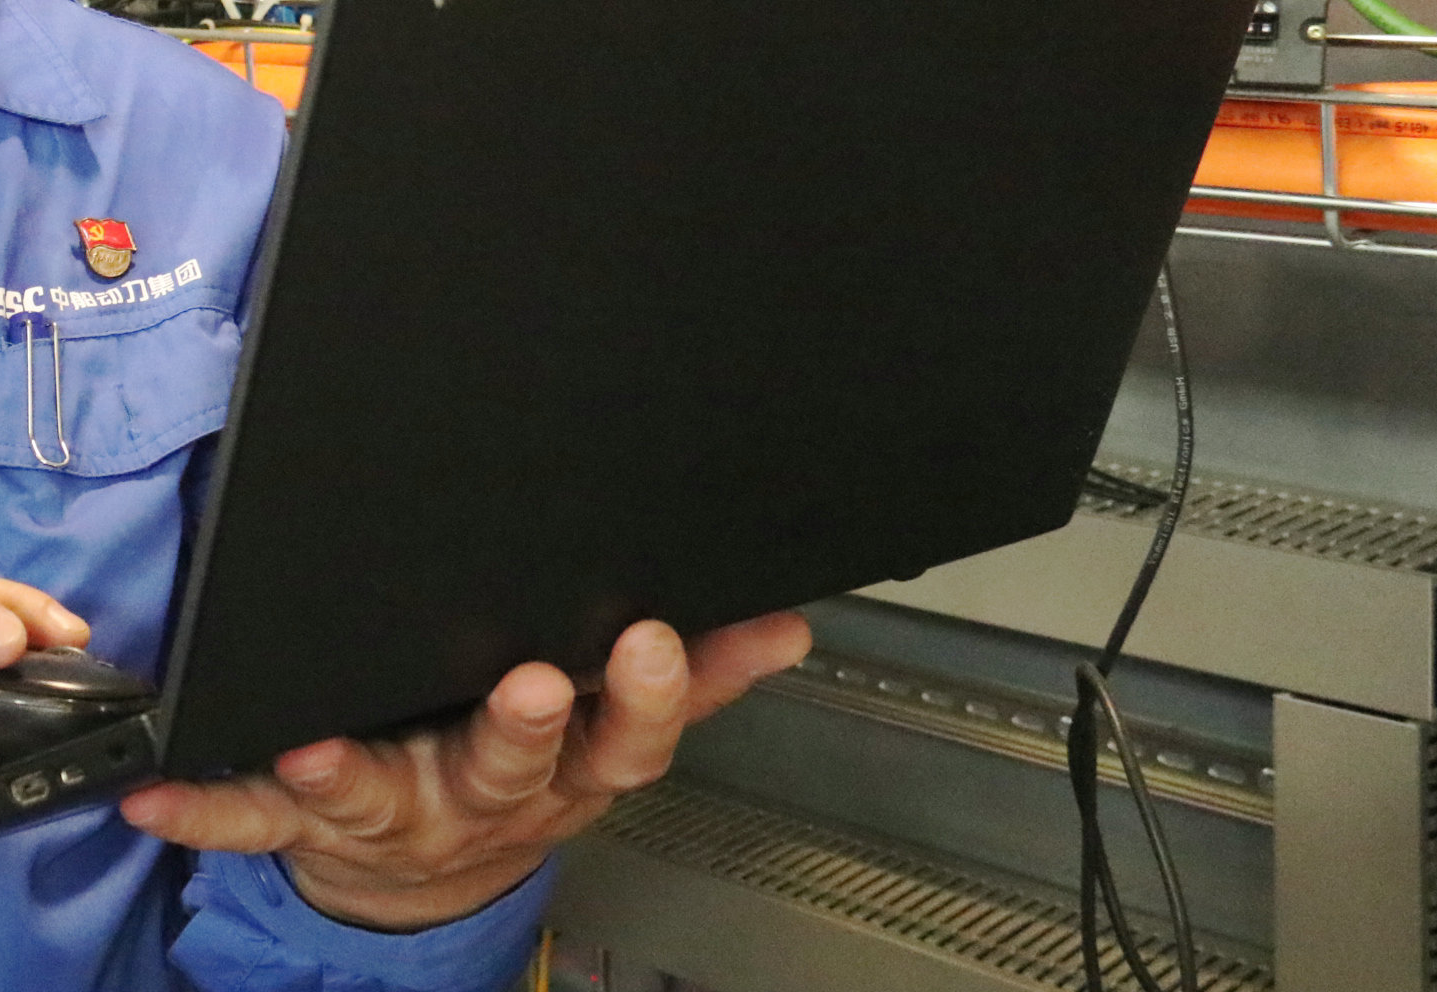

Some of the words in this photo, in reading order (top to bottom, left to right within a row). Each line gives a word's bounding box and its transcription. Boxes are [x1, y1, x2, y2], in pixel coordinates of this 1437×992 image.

[50, 258, 202, 311] 中船动力集团
[1167, 328, 1180, 353] USB
[1175, 377, 1188, 410] GmbH
[1171, 418, 1192, 504] Electronics
